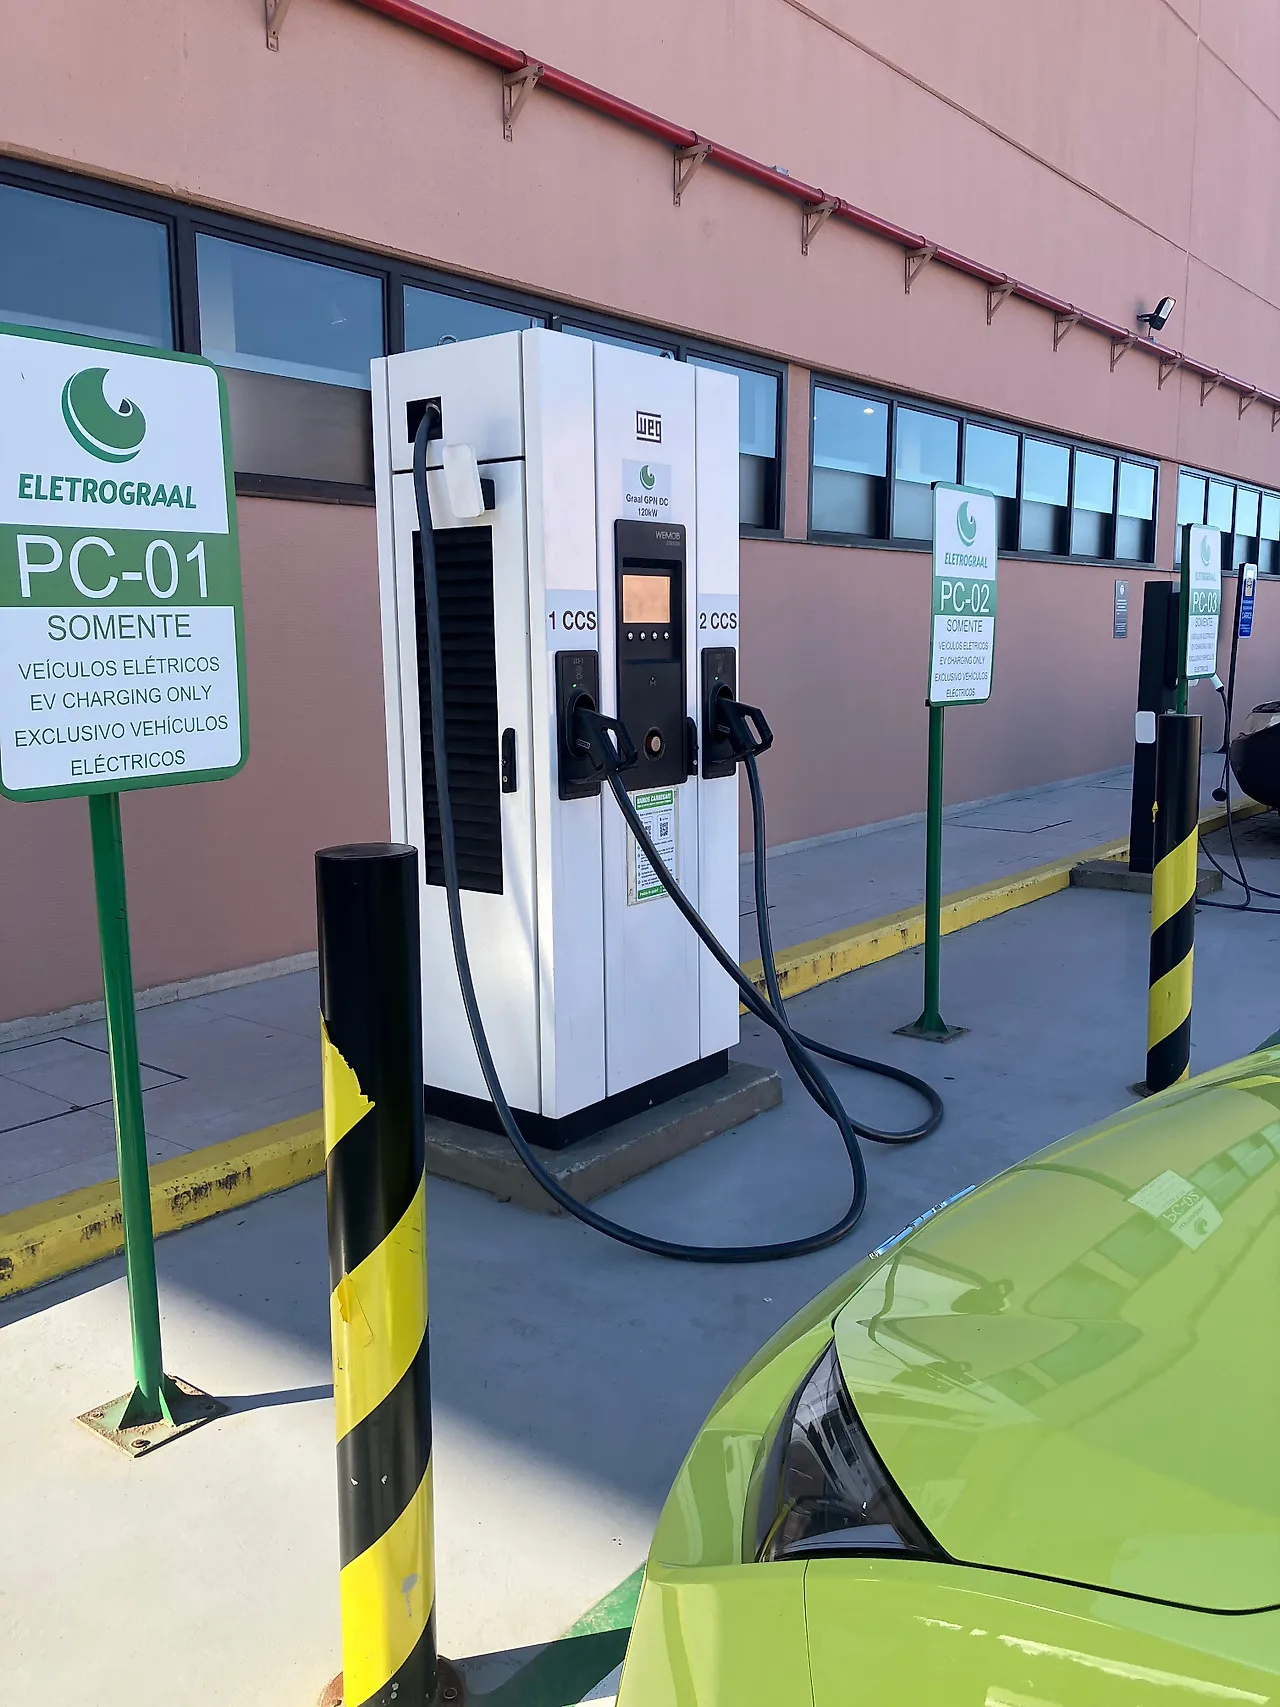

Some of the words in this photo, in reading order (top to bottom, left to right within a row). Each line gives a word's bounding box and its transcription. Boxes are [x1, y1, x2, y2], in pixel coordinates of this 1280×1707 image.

[18, 473, 197, 509] ELETROGRAAL
[625, 493, 643, 504] Graal
[644, 495, 658, 506] GPN
[658, 497, 669, 507] DC
[637, 507, 658, 518] 120kW
[16, 533, 209, 599] PC-01
[944, 552, 988, 569] ELETROGRAAL
[940, 580, 990, 613] PC-02
[1192, 591, 1218, 613] PC-03
[47, 613, 192, 642] SOMENTE
[549, 611, 556, 630] 1
[562, 610, 597, 631] CCS
[699, 612, 707, 630] 2
[710, 612, 737, 630] CCS
[946, 619, 983, 633] SOMENTE
[18, 656, 117, 681] VEÍCULOS
[122, 653, 220, 677] ELÉTRICOS
[30, 693, 57, 711] EV
[62, 688, 163, 710] CHARGING
[166, 684, 212, 704] ONLY
[14, 721, 126, 748] EXCLUSIVO
[129, 713, 229, 738] VEHÍCULOS
[70, 748, 186, 777] ELÉCTRICOS
